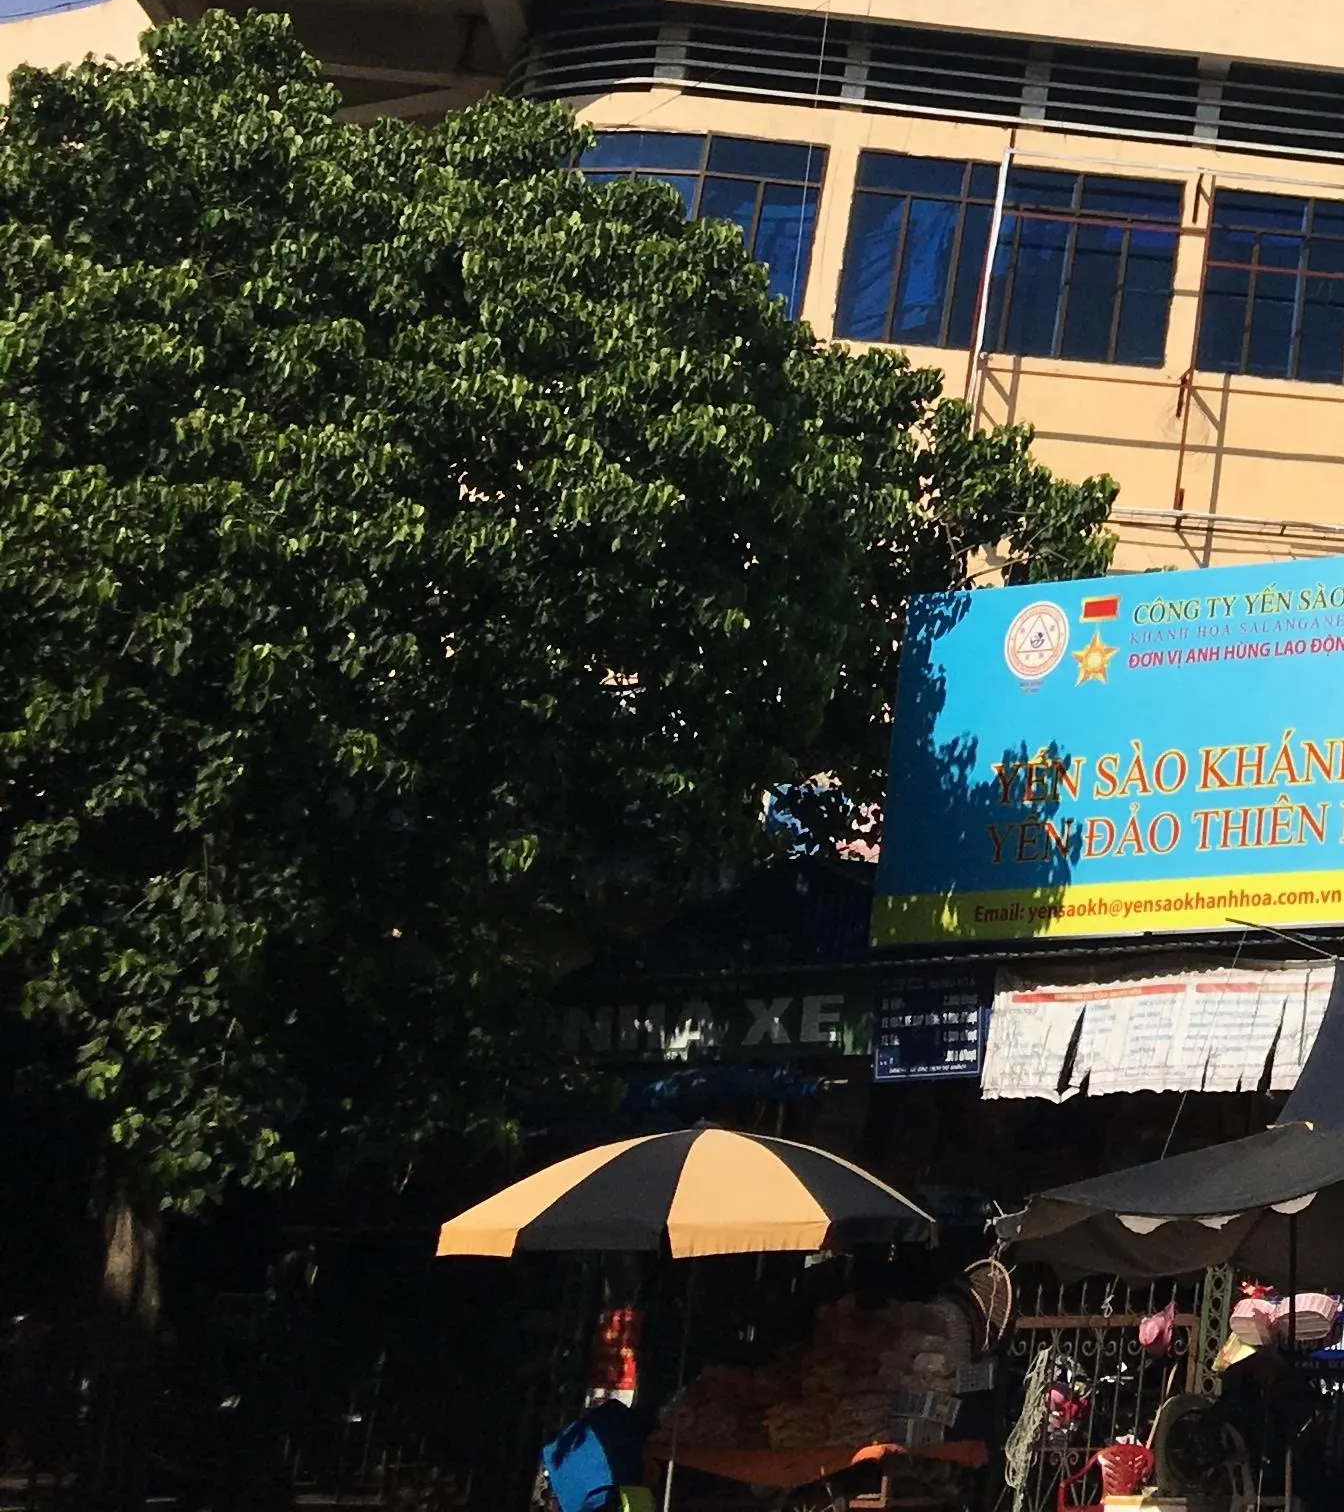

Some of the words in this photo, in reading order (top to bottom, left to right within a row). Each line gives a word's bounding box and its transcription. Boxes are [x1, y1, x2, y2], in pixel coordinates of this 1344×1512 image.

[1132, 595, 1200, 626] CÔNG
[1205, 595, 1238, 619] TY
[1244, 582, 1293, 615] YẾN
[1185, 645, 1221, 664] ANH
[1223, 640, 1271, 662] HÙNG
[1274, 638, 1306, 657] LAO
[993, 746, 1086, 807] YẾN
[1093, 739, 1188, 800] SÀO
[1083, 802, 1181, 859] ĐẢO
[1191, 792, 1332, 852] THIÊN
[974, 903, 1026, 924] Email:
[1028, 889, 1343, 922] yensaokh@yensaokhanhhoa.com.vn
[741, 994, 844, 1045] XE
